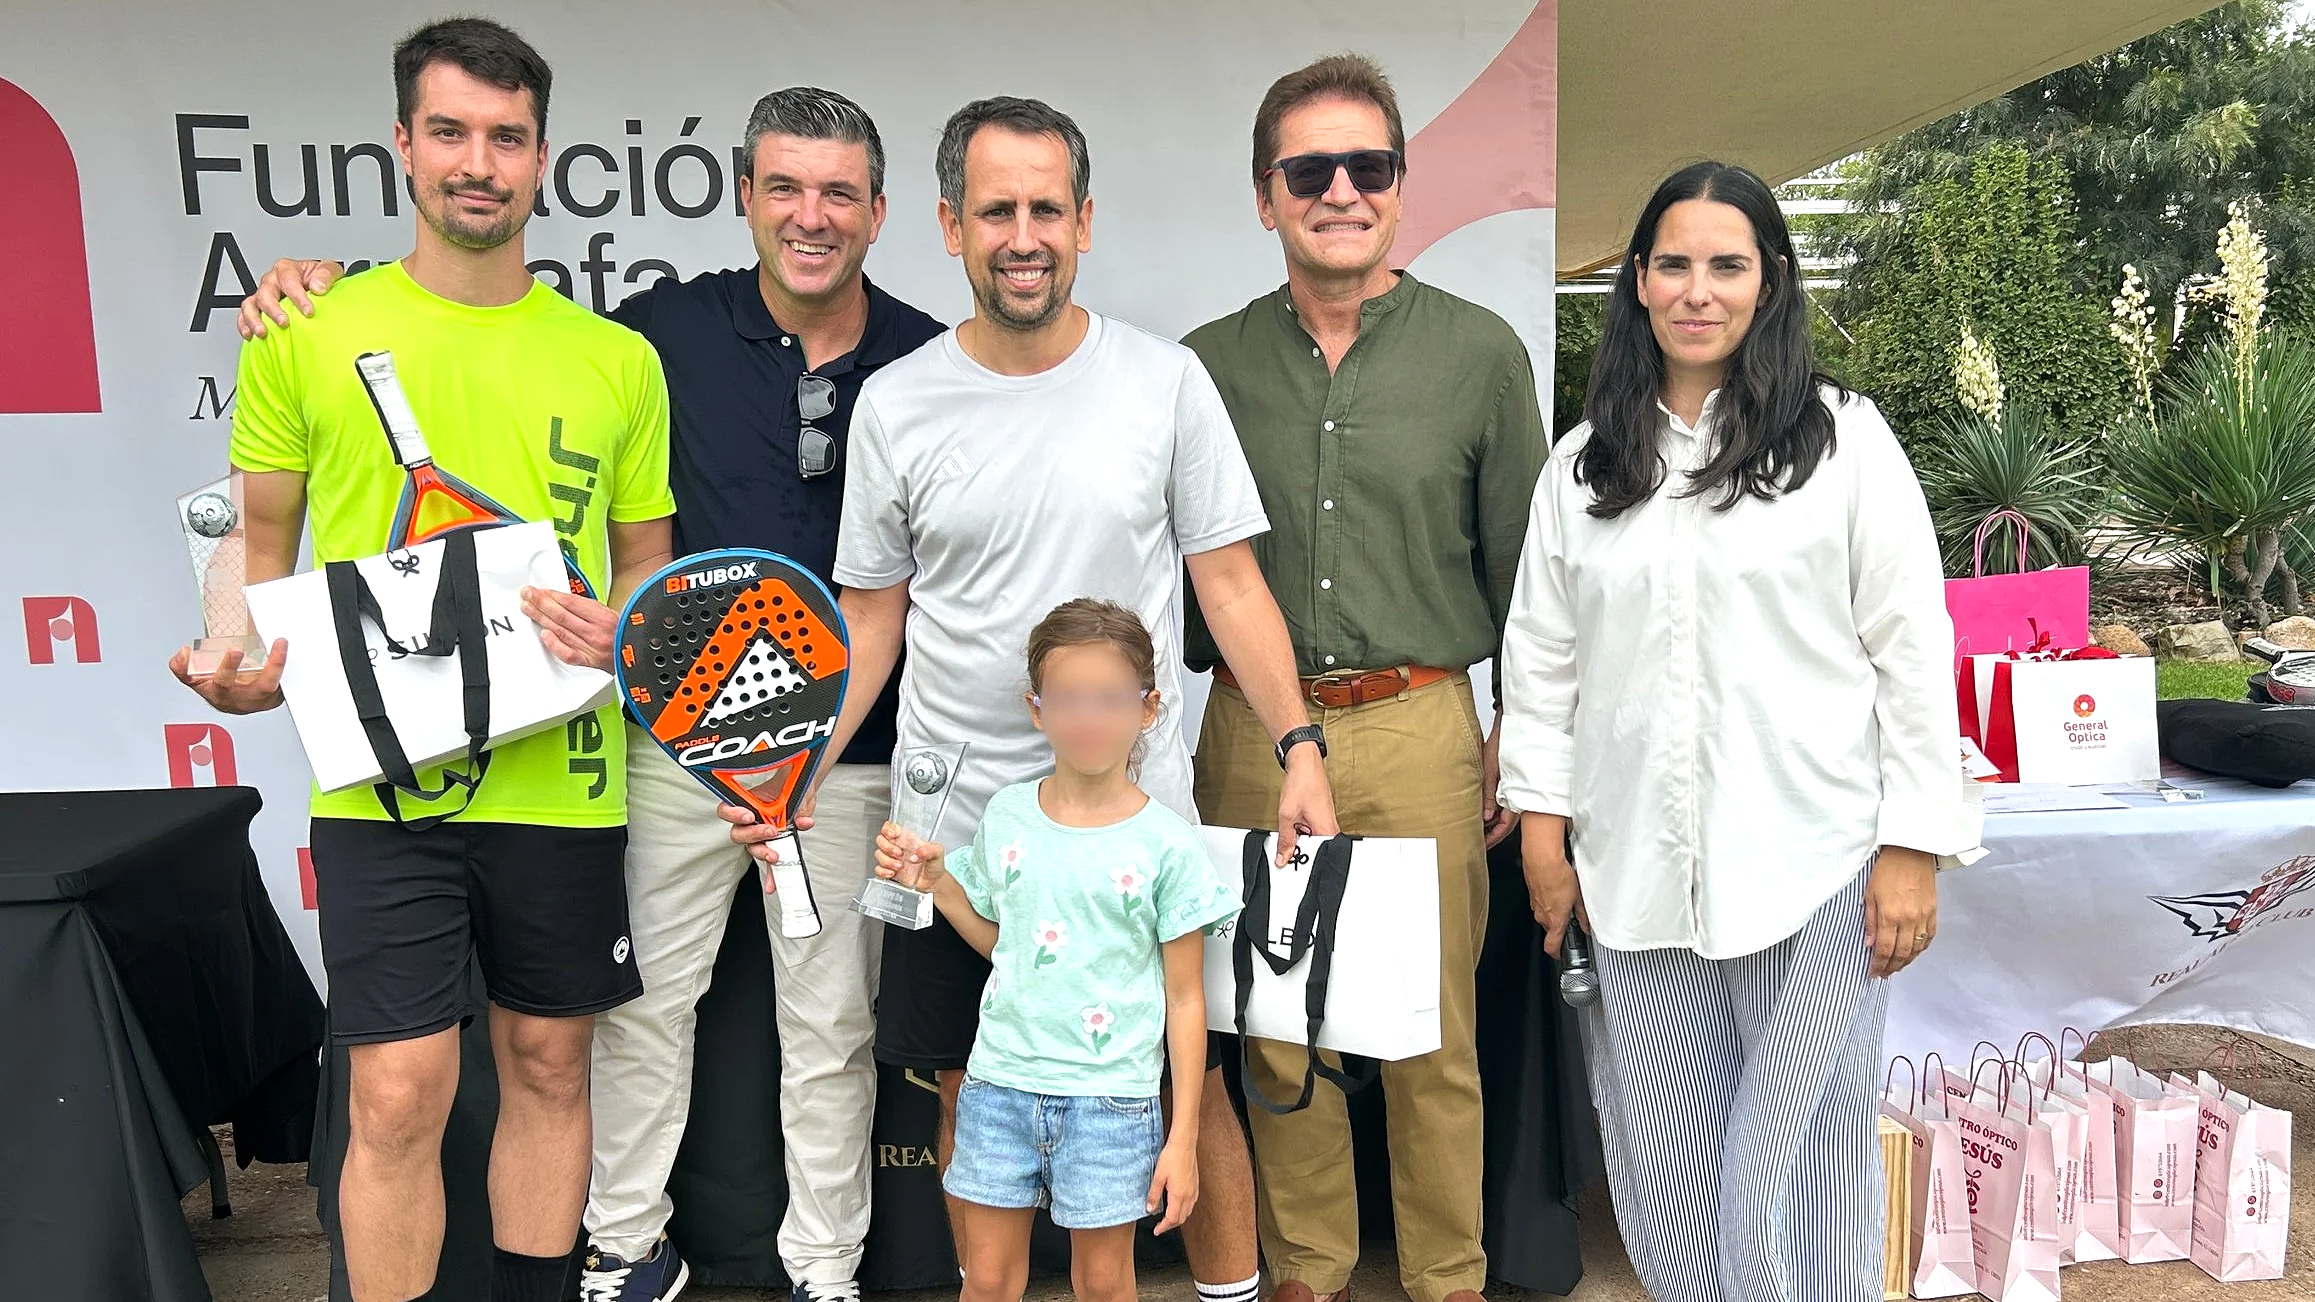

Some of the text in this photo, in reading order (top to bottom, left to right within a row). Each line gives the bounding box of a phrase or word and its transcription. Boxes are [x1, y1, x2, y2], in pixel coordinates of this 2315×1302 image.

[175, 113, 749, 219] Funció
[666, 562, 758, 594] BITUBOX
[2063, 719, 2109, 732] General
[2068, 731, 2106, 744] Optica
[674, 734, 720, 750] PADDLE
[678, 716, 837, 767] COACH
[1982, 1125, 2018, 1151] ÓPTICO
[879, 1144, 938, 1168] REA
[1960, 1136, 2004, 1170] ESÚS
